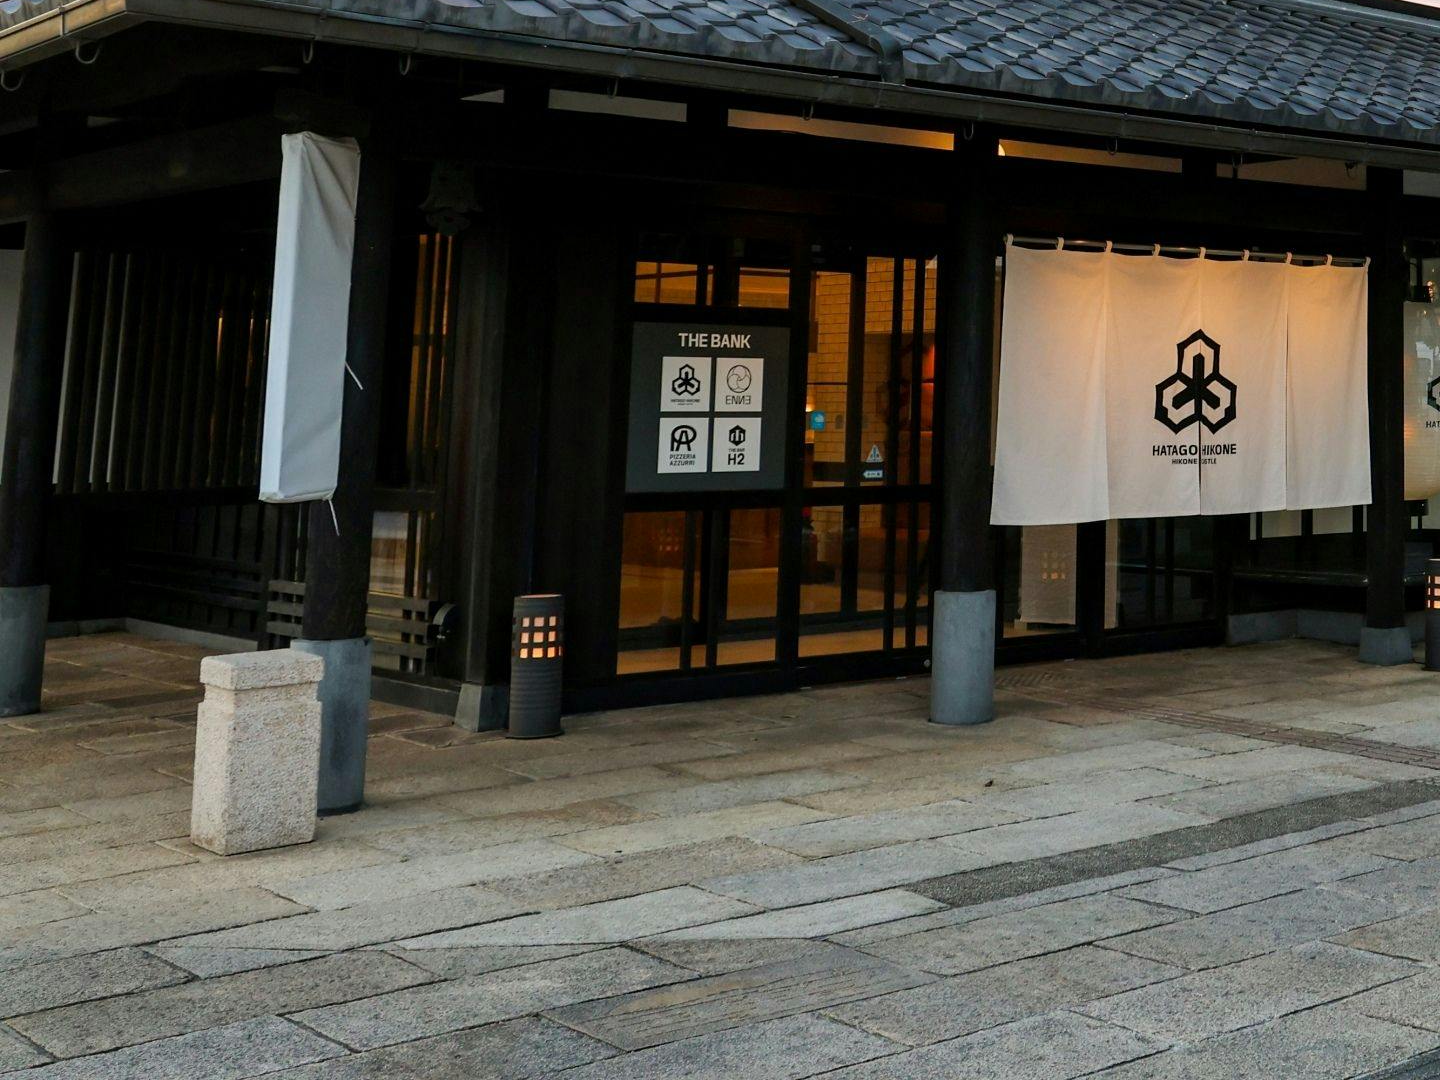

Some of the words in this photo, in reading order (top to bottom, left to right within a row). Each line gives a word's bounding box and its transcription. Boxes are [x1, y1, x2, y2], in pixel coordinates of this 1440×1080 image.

[678, 332, 708, 348] THE
[710, 333, 752, 349] BANK
[1152, 444, 1198, 456] HATAGO
[1201, 443, 1237, 456] HIKONE
[727, 453, 745, 465] H2
